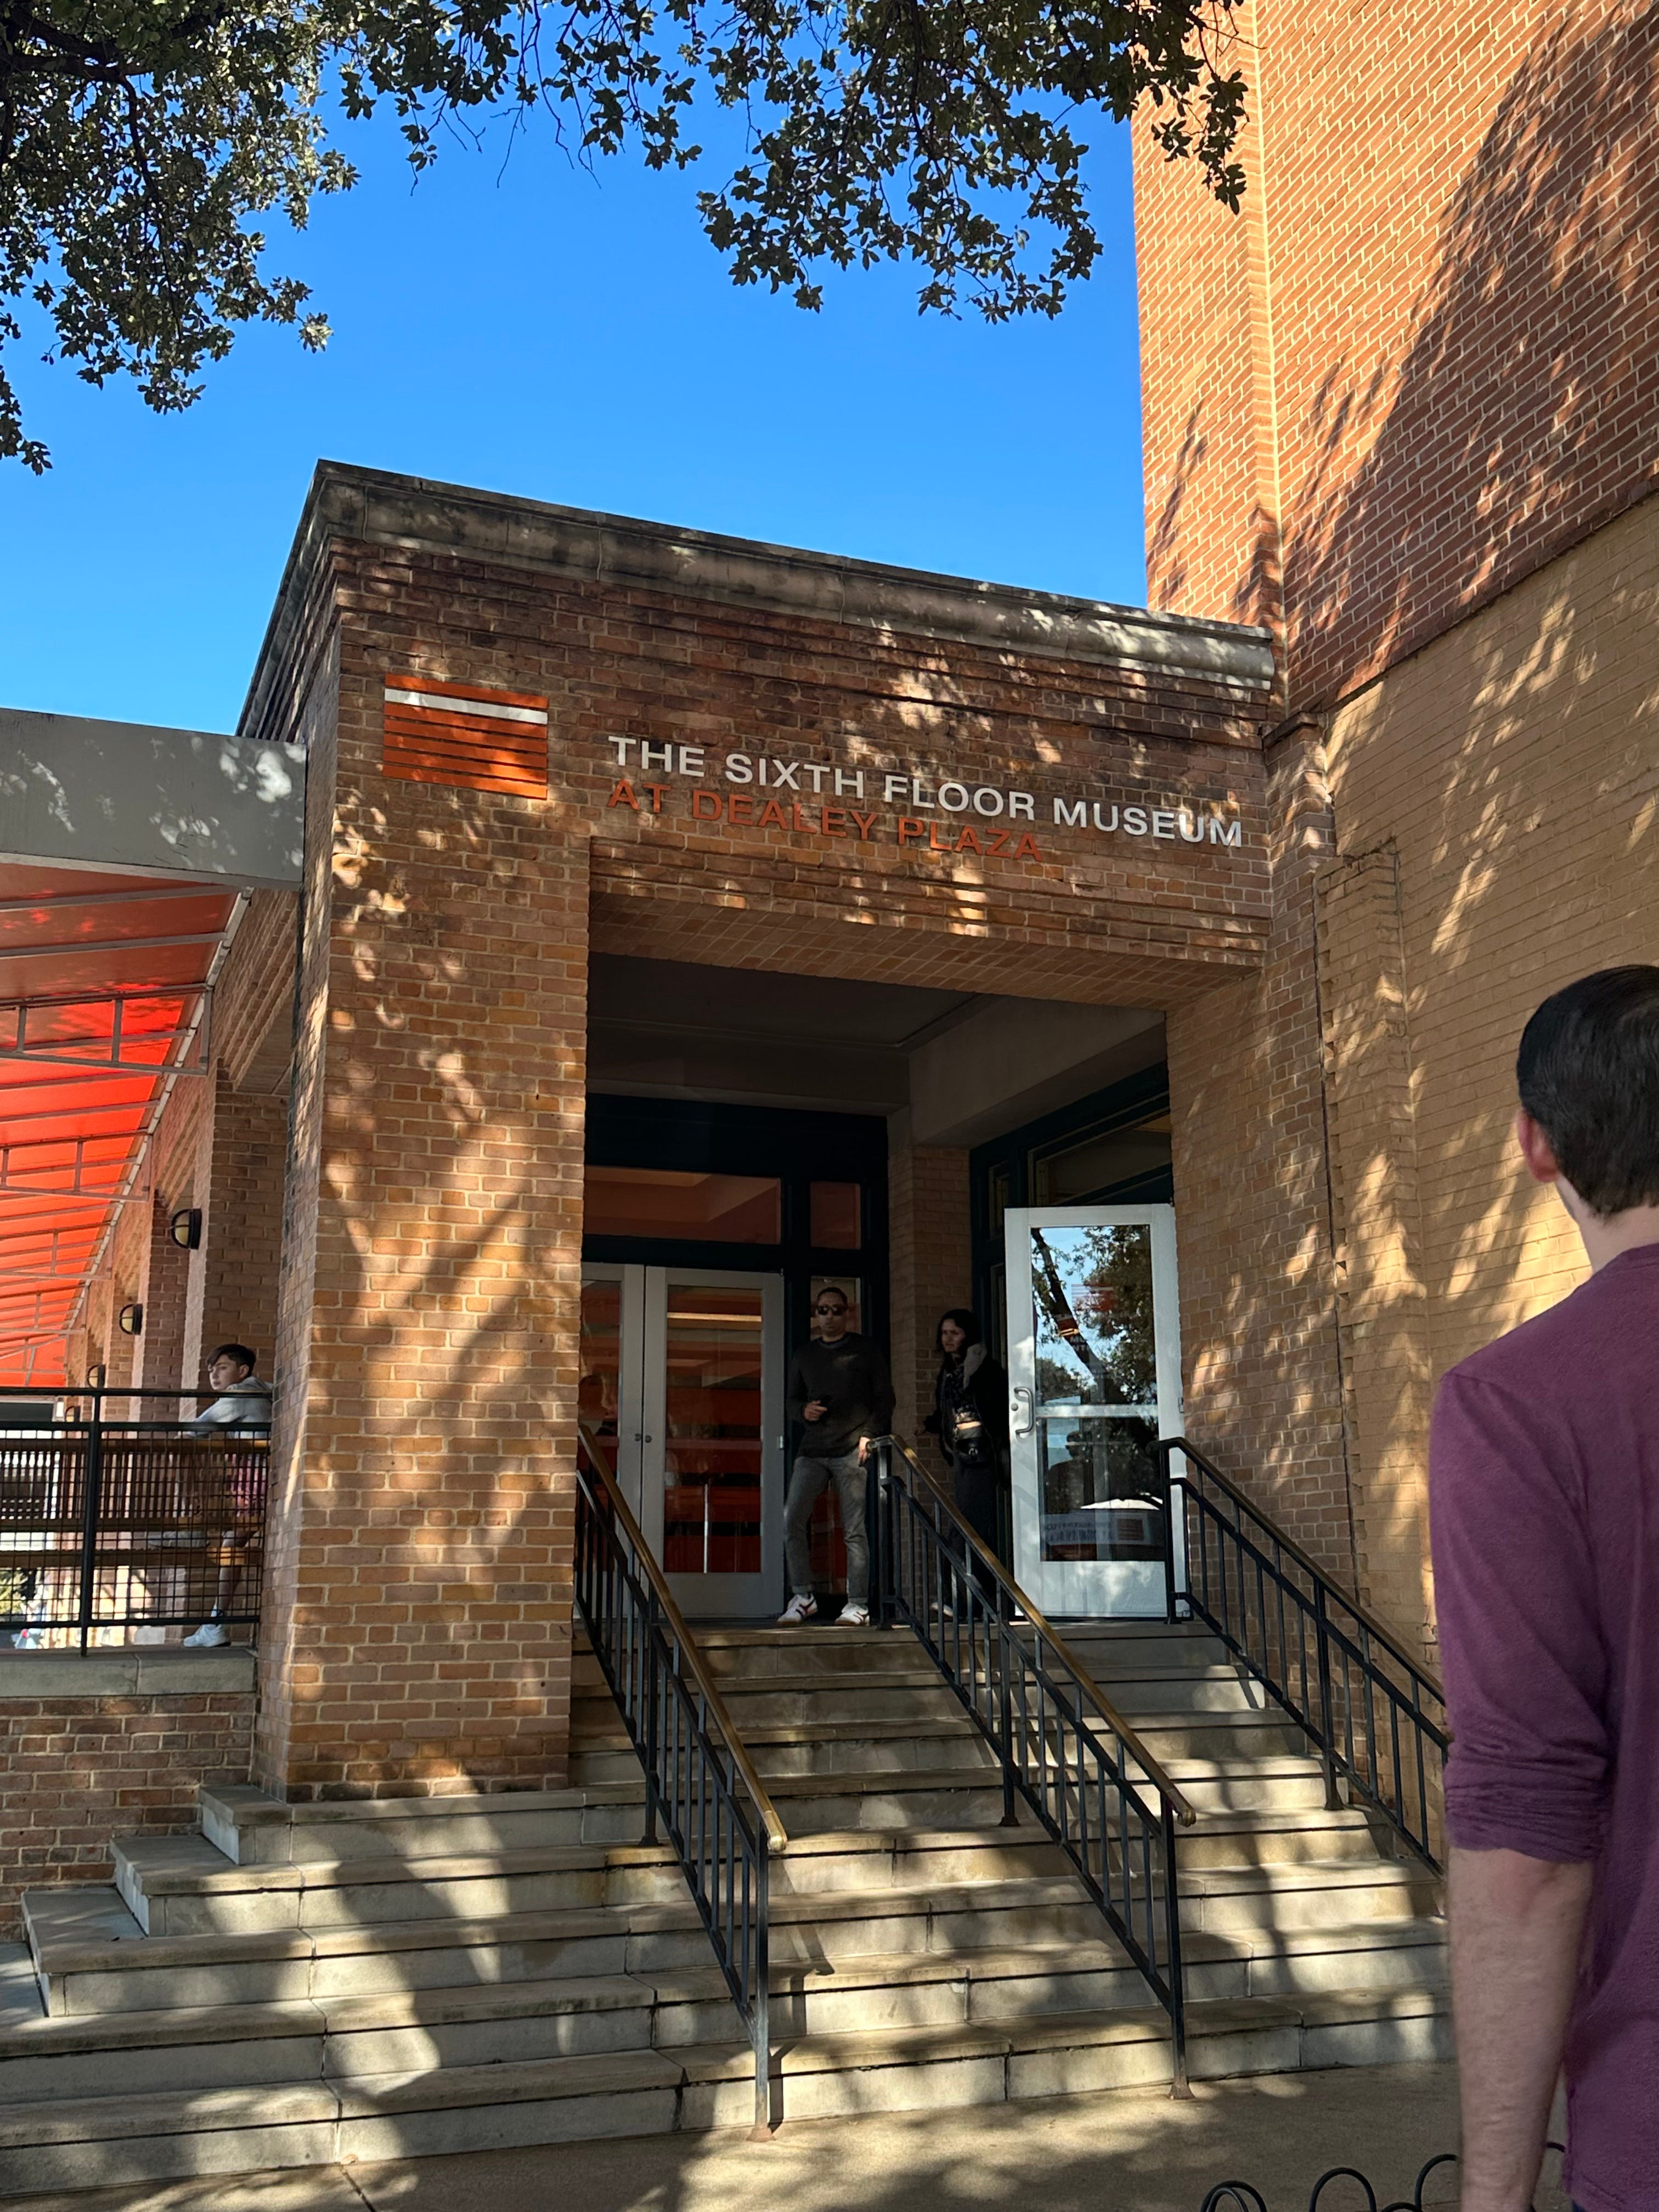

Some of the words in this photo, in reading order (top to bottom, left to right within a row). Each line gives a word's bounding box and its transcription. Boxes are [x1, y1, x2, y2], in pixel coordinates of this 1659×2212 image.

[607, 779, 672, 814] AT
[692, 789, 879, 841] DEALEY
[898, 816, 1042, 862] PLAZA
[608, 735, 706, 778] THE
[725, 753, 865, 799] SIXTH
[883, 774, 1035, 821] FLOOR
[1053, 797, 1243, 848] MUSEUM
